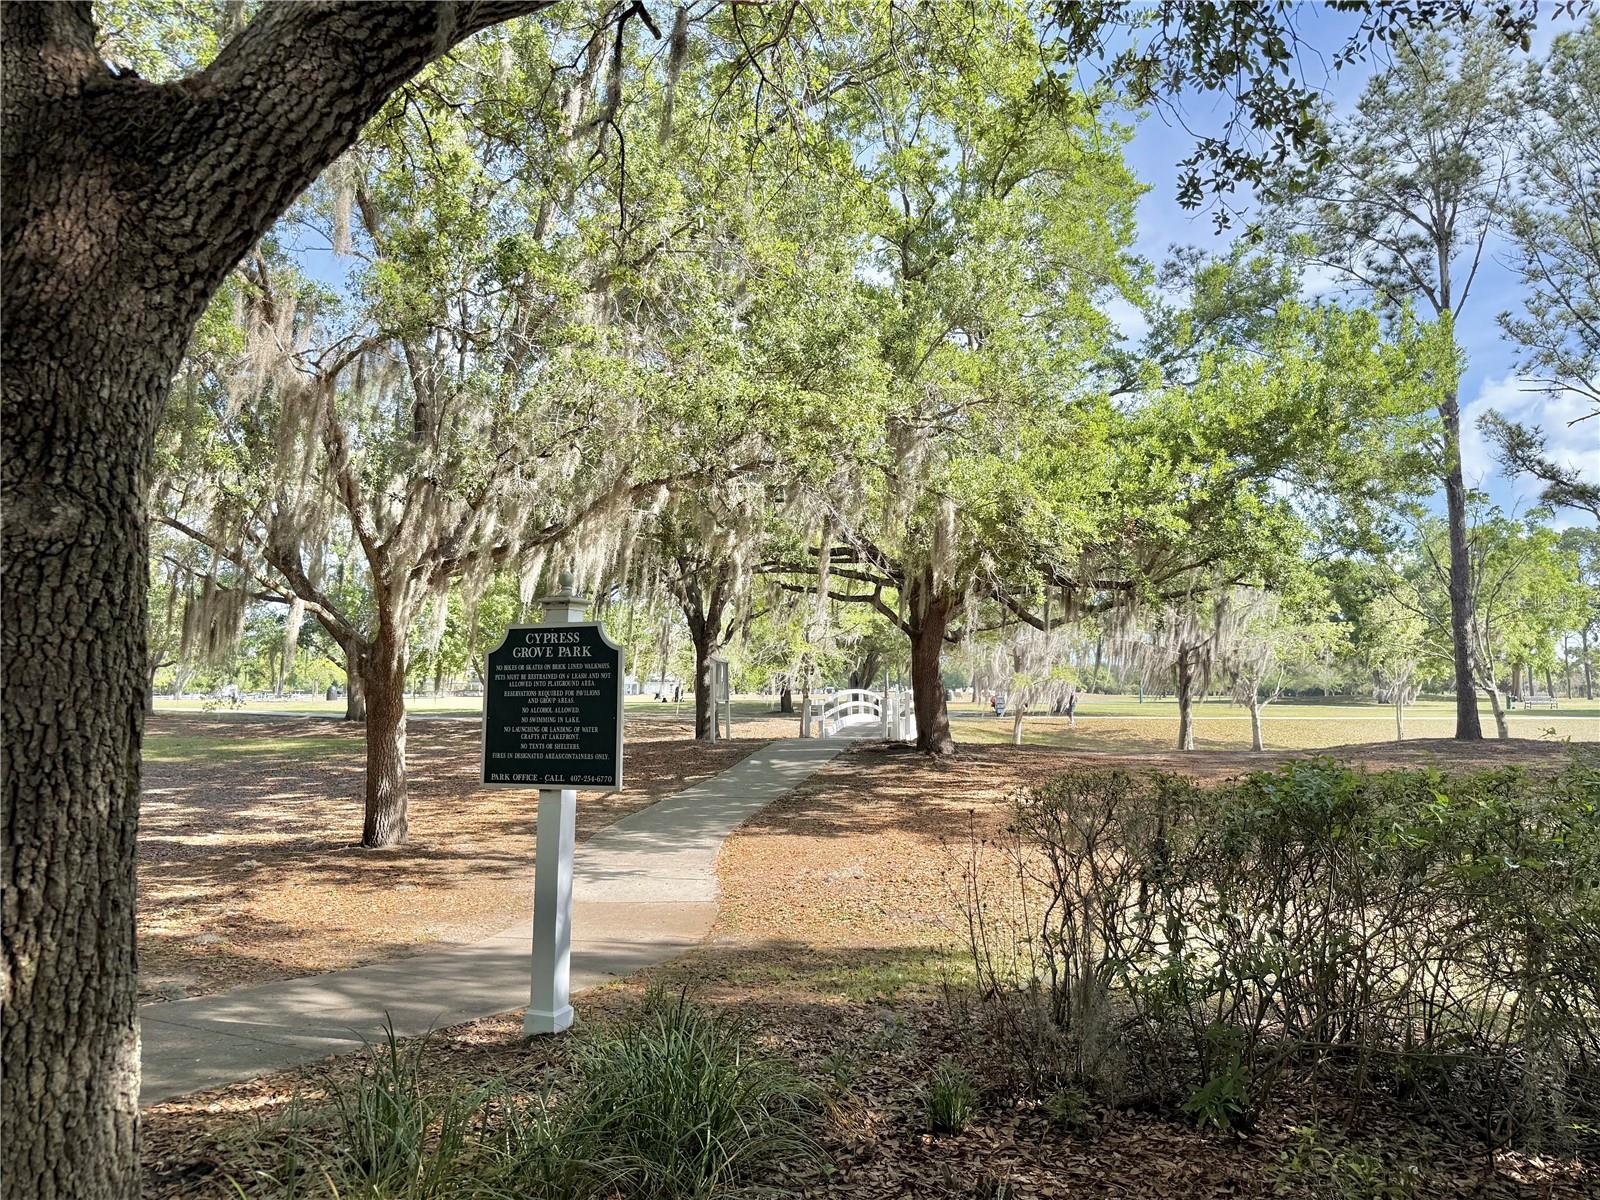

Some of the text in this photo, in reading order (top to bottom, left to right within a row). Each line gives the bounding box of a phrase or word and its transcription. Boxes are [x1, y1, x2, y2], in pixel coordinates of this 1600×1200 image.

[525, 632, 580, 644] CYPRESS
[512, 646, 592, 658] GROVE PARK
[537, 690, 564, 698] REQUIRED
[491, 773, 511, 781] PARK
[512, 773, 538, 781] OFFICE
[544, 774, 566, 782] CALL
[570, 775, 613, 783] 407-254-6770
